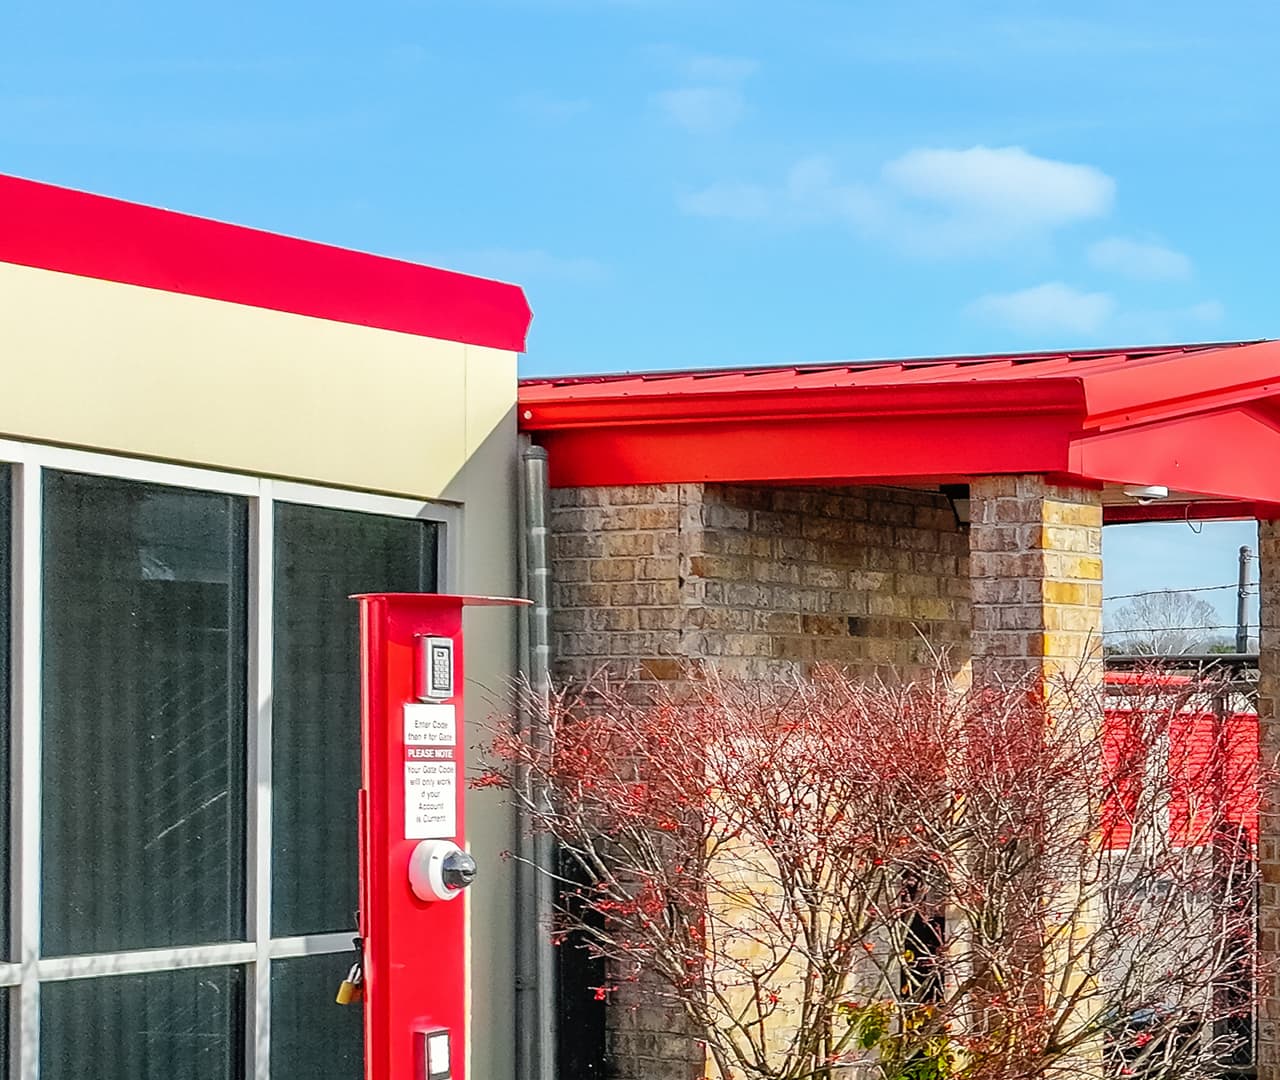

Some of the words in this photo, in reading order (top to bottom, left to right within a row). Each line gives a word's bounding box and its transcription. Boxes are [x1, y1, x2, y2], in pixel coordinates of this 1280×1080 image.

[432, 720, 448, 729] Code
[407, 749, 435, 758] PLEASE
[435, 749, 453, 758] NOTE
